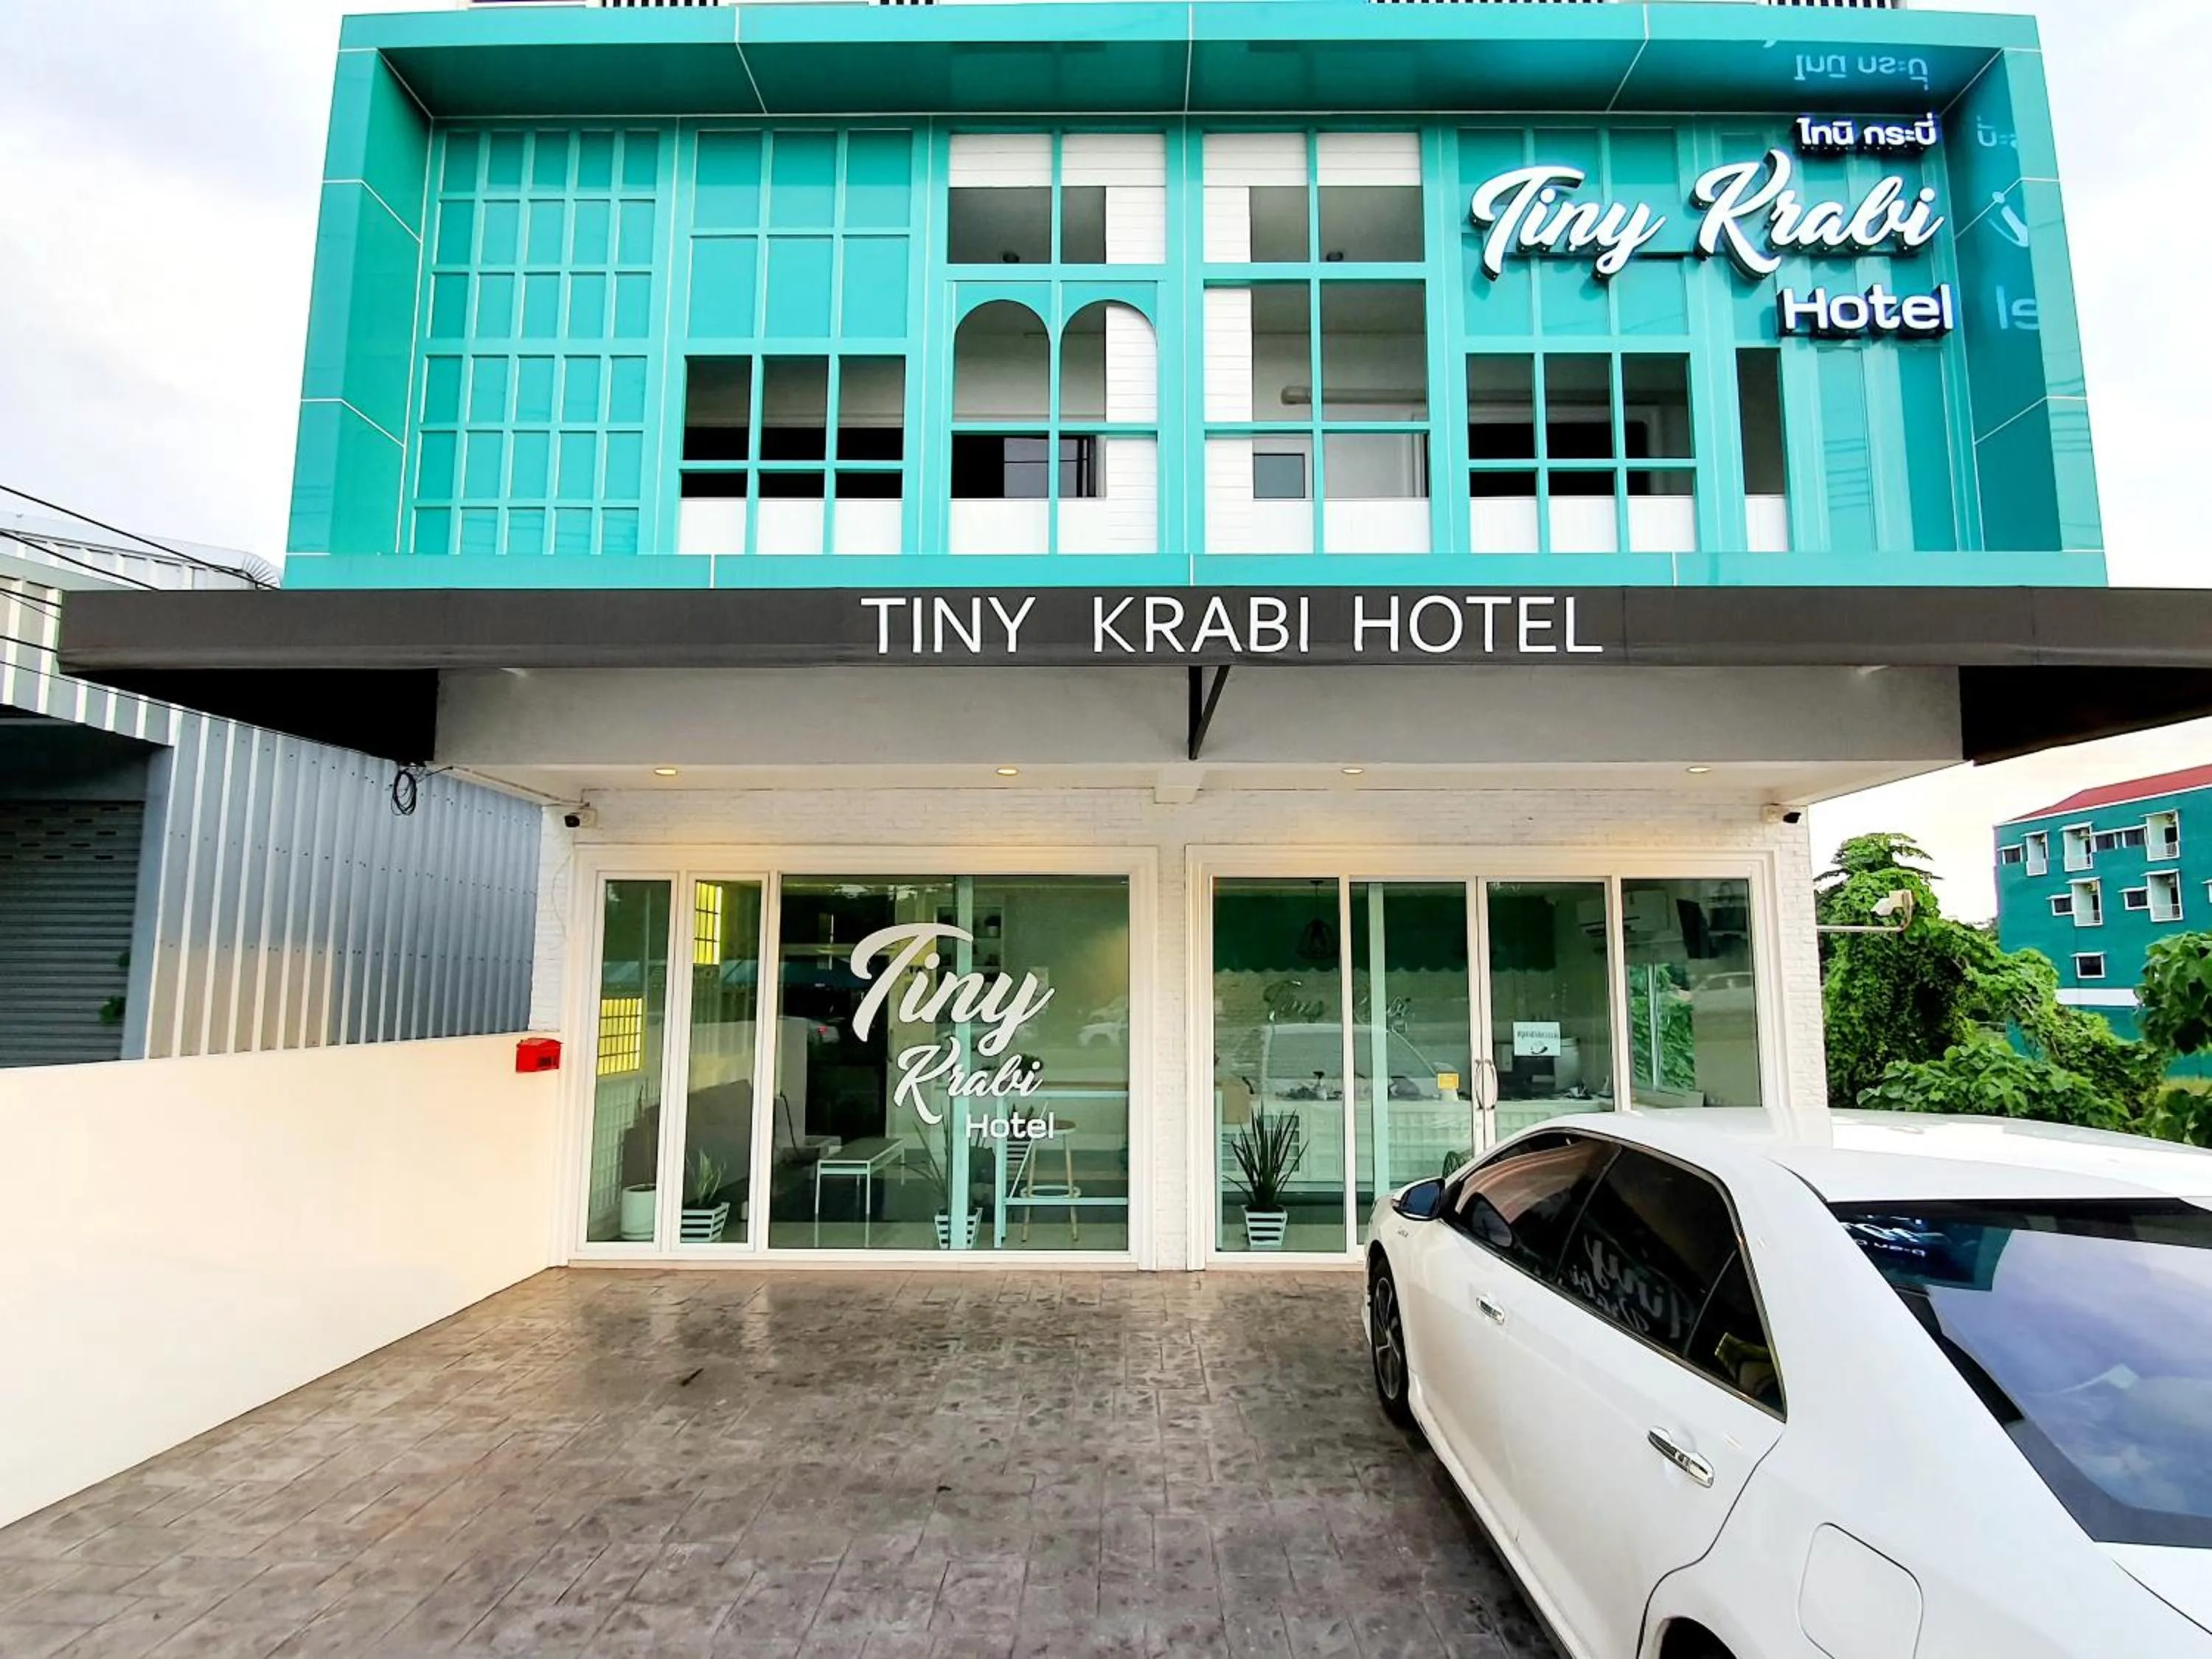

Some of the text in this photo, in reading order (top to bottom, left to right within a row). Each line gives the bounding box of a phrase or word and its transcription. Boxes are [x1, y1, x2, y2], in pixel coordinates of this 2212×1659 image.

[1863, 112, 1937, 145] กระบี่
[1471, 166, 1667, 274] Tiny
[1694, 149, 1945, 274] Krabi
[1783, 284, 1953, 330] Hotel
[860, 595, 1604, 654] TINY KRABI HOTEL
[850, 922, 1055, 1057] Tiny
[893, 1036, 1043, 1124] Krabi
[965, 1111, 1054, 1139] Hotel
